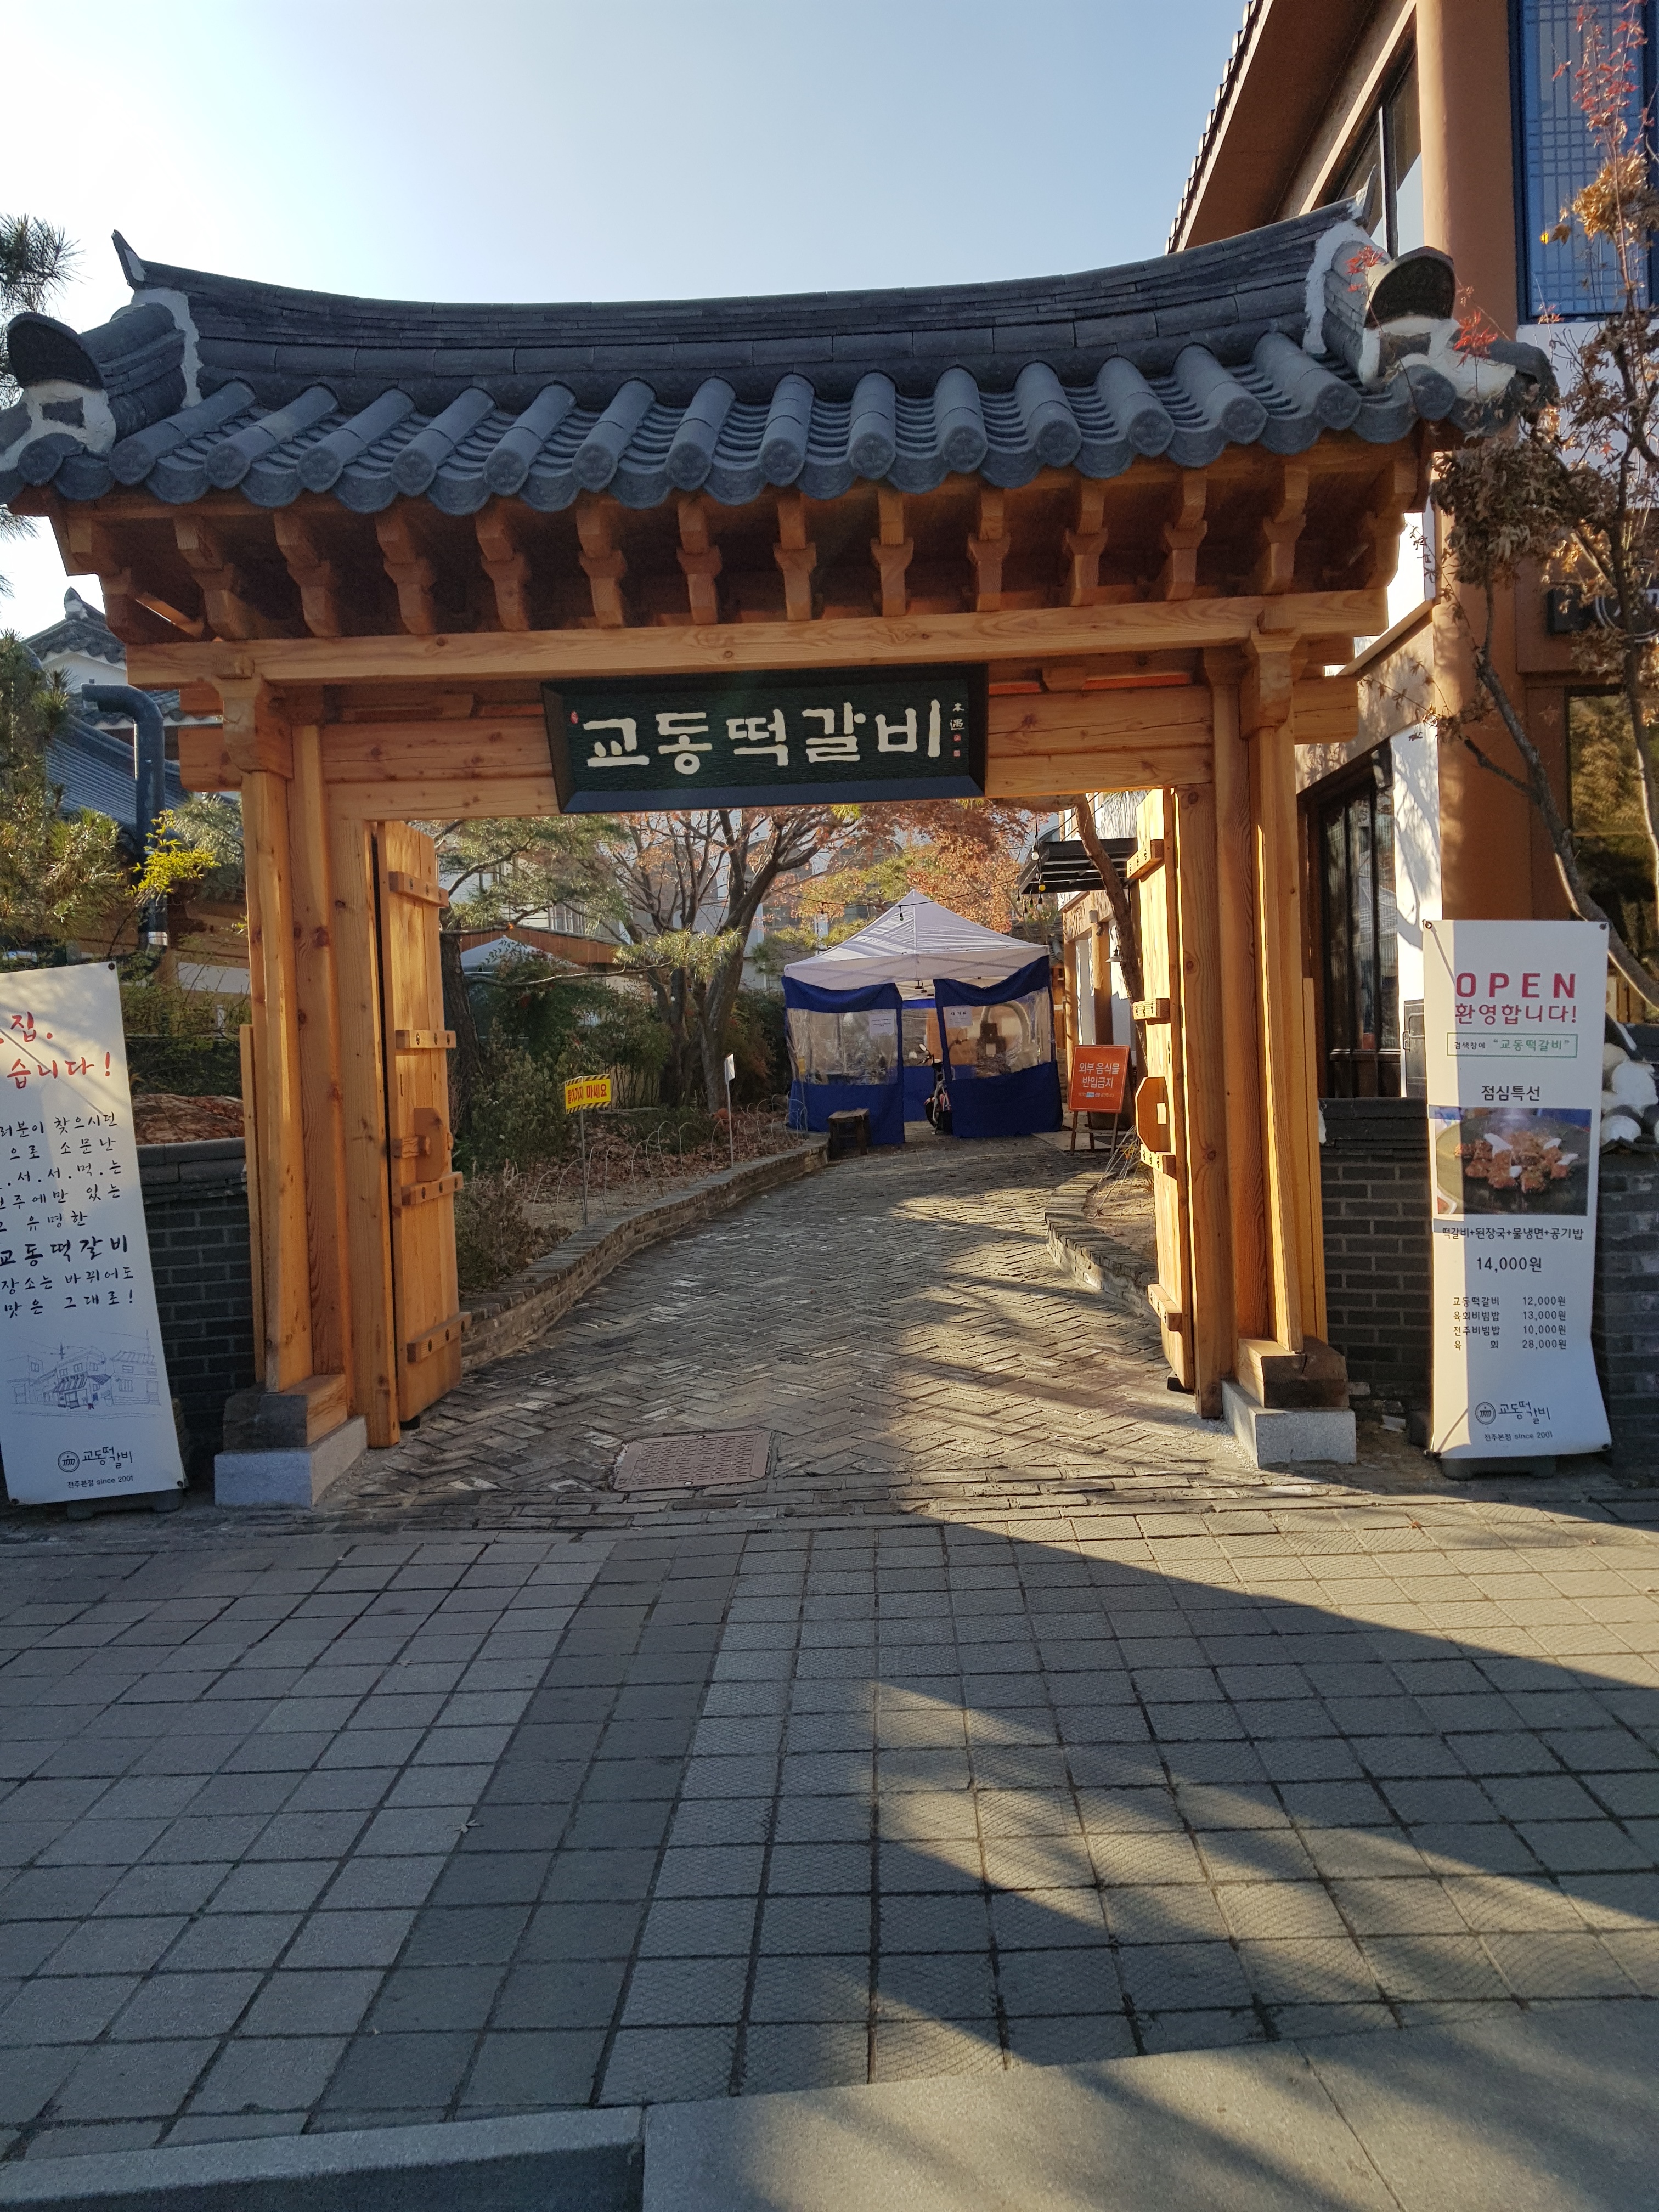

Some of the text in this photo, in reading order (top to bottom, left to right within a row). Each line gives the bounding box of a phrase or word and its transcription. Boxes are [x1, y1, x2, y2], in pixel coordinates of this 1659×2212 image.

[583, 699, 940, 775] 교동떡갈비
[1457, 972, 1576, 998] OPEN
[1455, 1003, 1577, 1025] 환영합니다!
[1454, 1041, 1486, 1050] 검색창에
[7, 1052, 110, 1090] 습니다!
[1079, 1062, 1120, 1075] 외부 음식물
[1082, 1076, 1113, 1089] 반입금지
[567, 1083, 607, 1104] 들어가지 마세요
[1481, 1085, 1541, 1101] 점심특선
[54, 1111, 117, 1135] 찾으시던
[60, 1137, 116, 1154] 소문난
[86, 1183, 120, 1202] 있는
[27, 1210, 88, 1231] 유명한
[0, 1234, 127, 1267] 교동떡갈비
[1477, 1256, 1542, 1273] 14,000원
[1, 1267, 134, 1295] 장소는 바뀌어도
[4, 1289, 133, 1318] 맛은 그대로!
[1453, 1296, 1566, 1307] 교동떡갈비 12,000원
[1453, 1311, 1566, 1322] 육회비빔밥 13,000원
[1453, 1325, 1566, 1336] 전주비빔밥 10,000원
[1522, 1340, 1567, 1350] 28,000원
[1498, 1401, 1550, 1424] 교동떡갈비
[1537, 1430, 1553, 1438] 2001
[82, 1446, 133, 1469] 교동떡갈비
[67, 1480, 94, 1488] 전주본점
